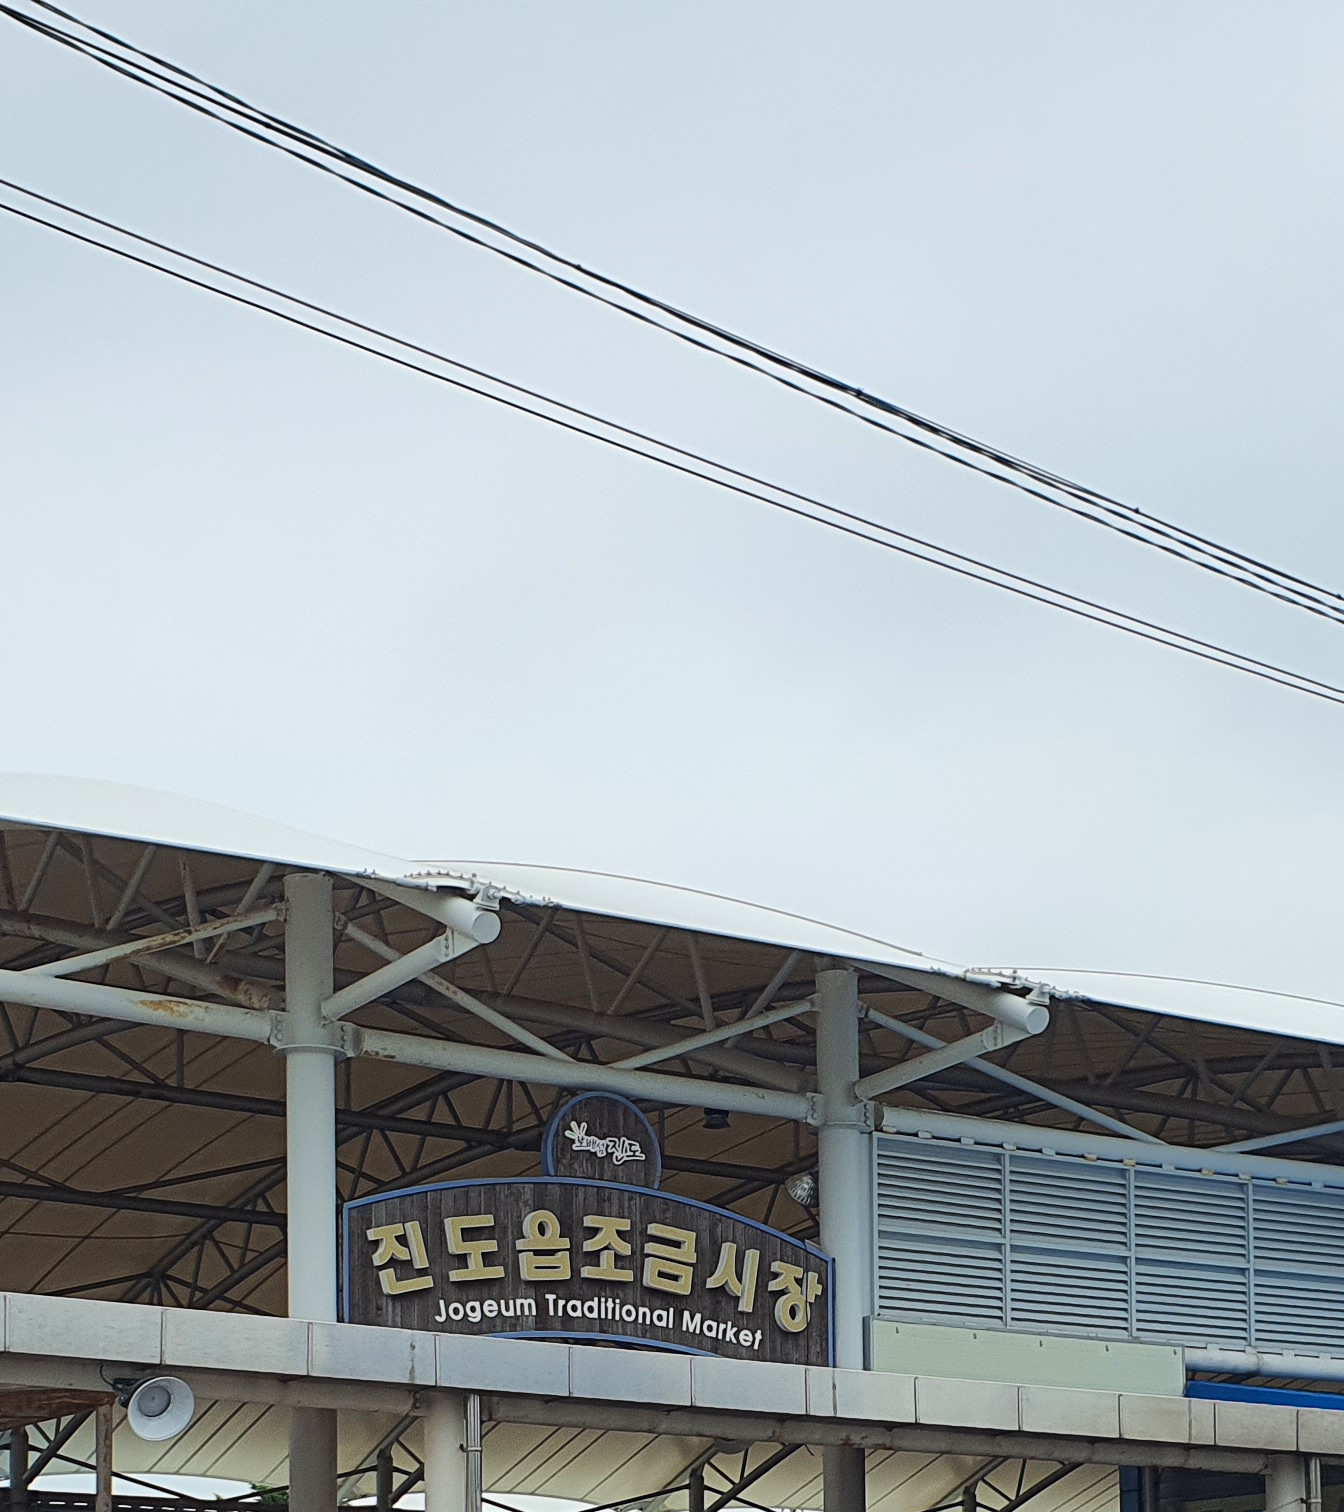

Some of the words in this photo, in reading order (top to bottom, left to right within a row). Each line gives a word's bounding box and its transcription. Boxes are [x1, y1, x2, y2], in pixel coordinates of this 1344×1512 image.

[367, 1209, 824, 1334] 진도읍조금시장
[435, 1297, 537, 1324] Jogeum
[545, 1293, 674, 1329] Traditional
[682, 1311, 763, 1351] Market
